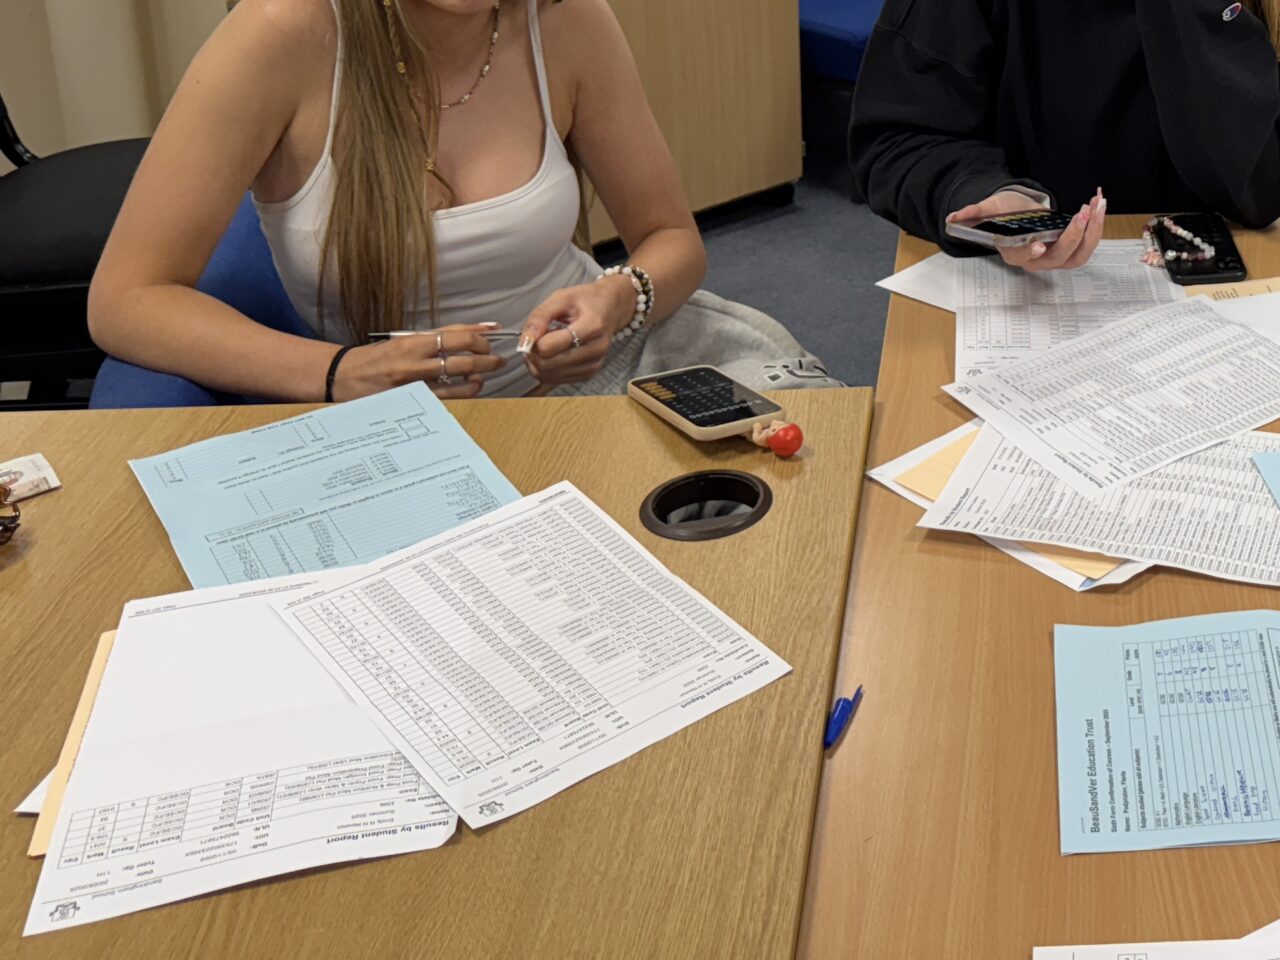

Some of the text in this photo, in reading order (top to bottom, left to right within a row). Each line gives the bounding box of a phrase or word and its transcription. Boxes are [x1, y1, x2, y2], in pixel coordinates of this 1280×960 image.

[1084, 718, 1100, 832] BeauSandVer Education Trust
[414, 819, 449, 830] Results
[325, 833, 358, 843] Report
[360, 828, 397, 838] Student
